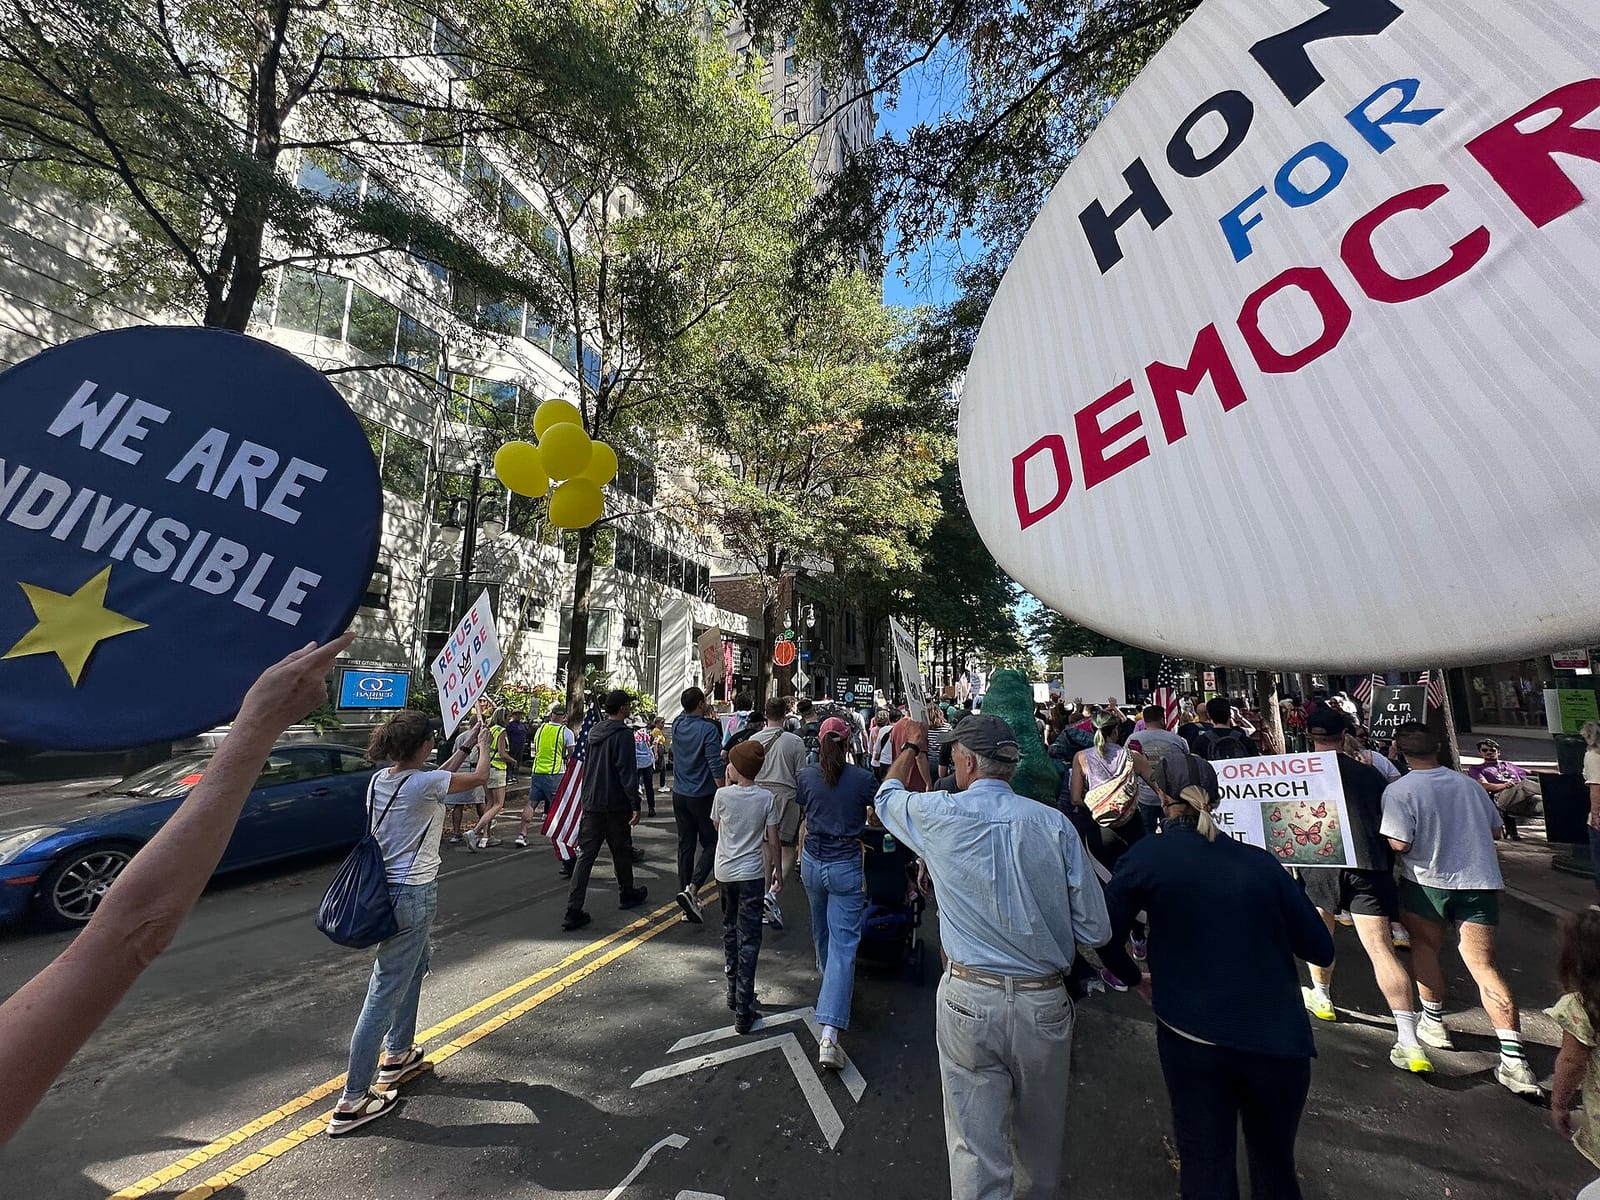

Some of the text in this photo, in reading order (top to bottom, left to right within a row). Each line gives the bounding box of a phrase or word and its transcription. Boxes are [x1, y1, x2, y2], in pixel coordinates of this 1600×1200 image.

[1218, 78, 1445, 262] FOR
[1012, 78, 1600, 530] DEMOCR
[47, 380, 328, 525] WE ARE
[438, 608, 478, 674] REFUSE
[443, 626, 487, 698] TO BE
[359, 677, 393, 691] QC
[450, 657, 491, 721] RULED
[854, 684, 873, 693] KIND
[1387, 703, 1411, 711] am
[1392, 689, 1400, 699] I
[1222, 757, 1323, 779] ORANGE
